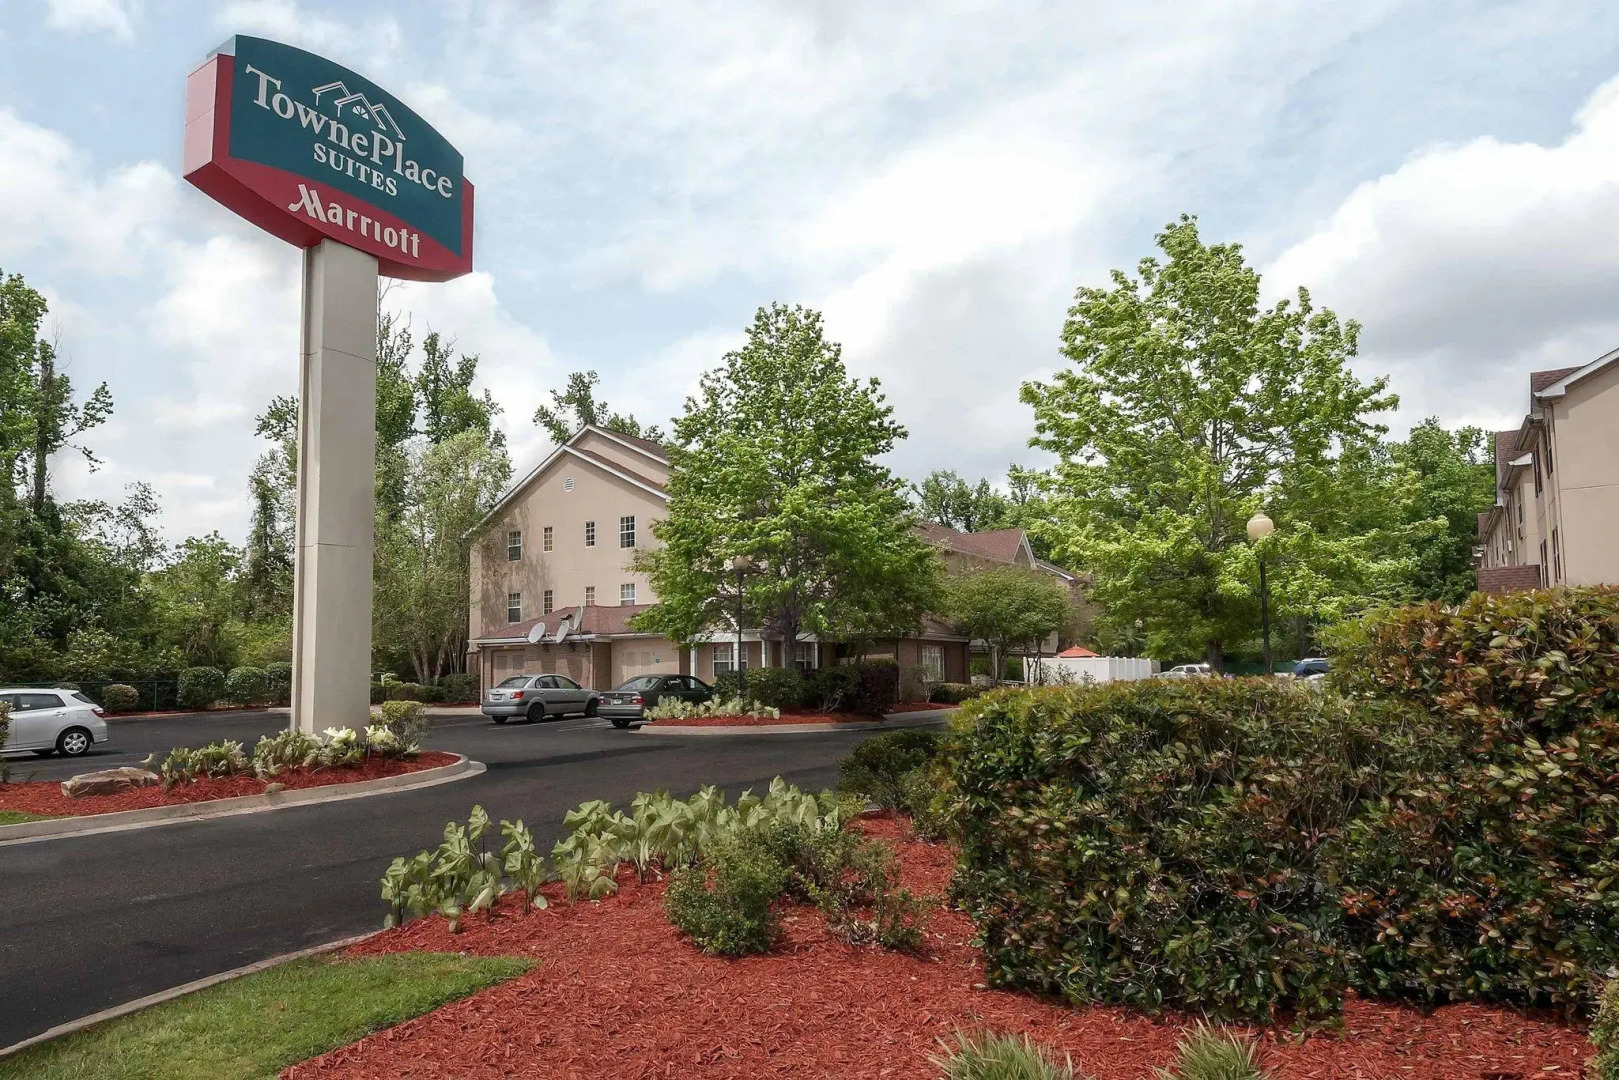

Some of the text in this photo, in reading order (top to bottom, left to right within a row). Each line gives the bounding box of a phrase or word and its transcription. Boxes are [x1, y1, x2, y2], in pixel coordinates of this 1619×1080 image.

[245, 64, 453, 198] TownePlace
[313, 143, 398, 196] SUITES
[288, 184, 420, 258] Marriott
